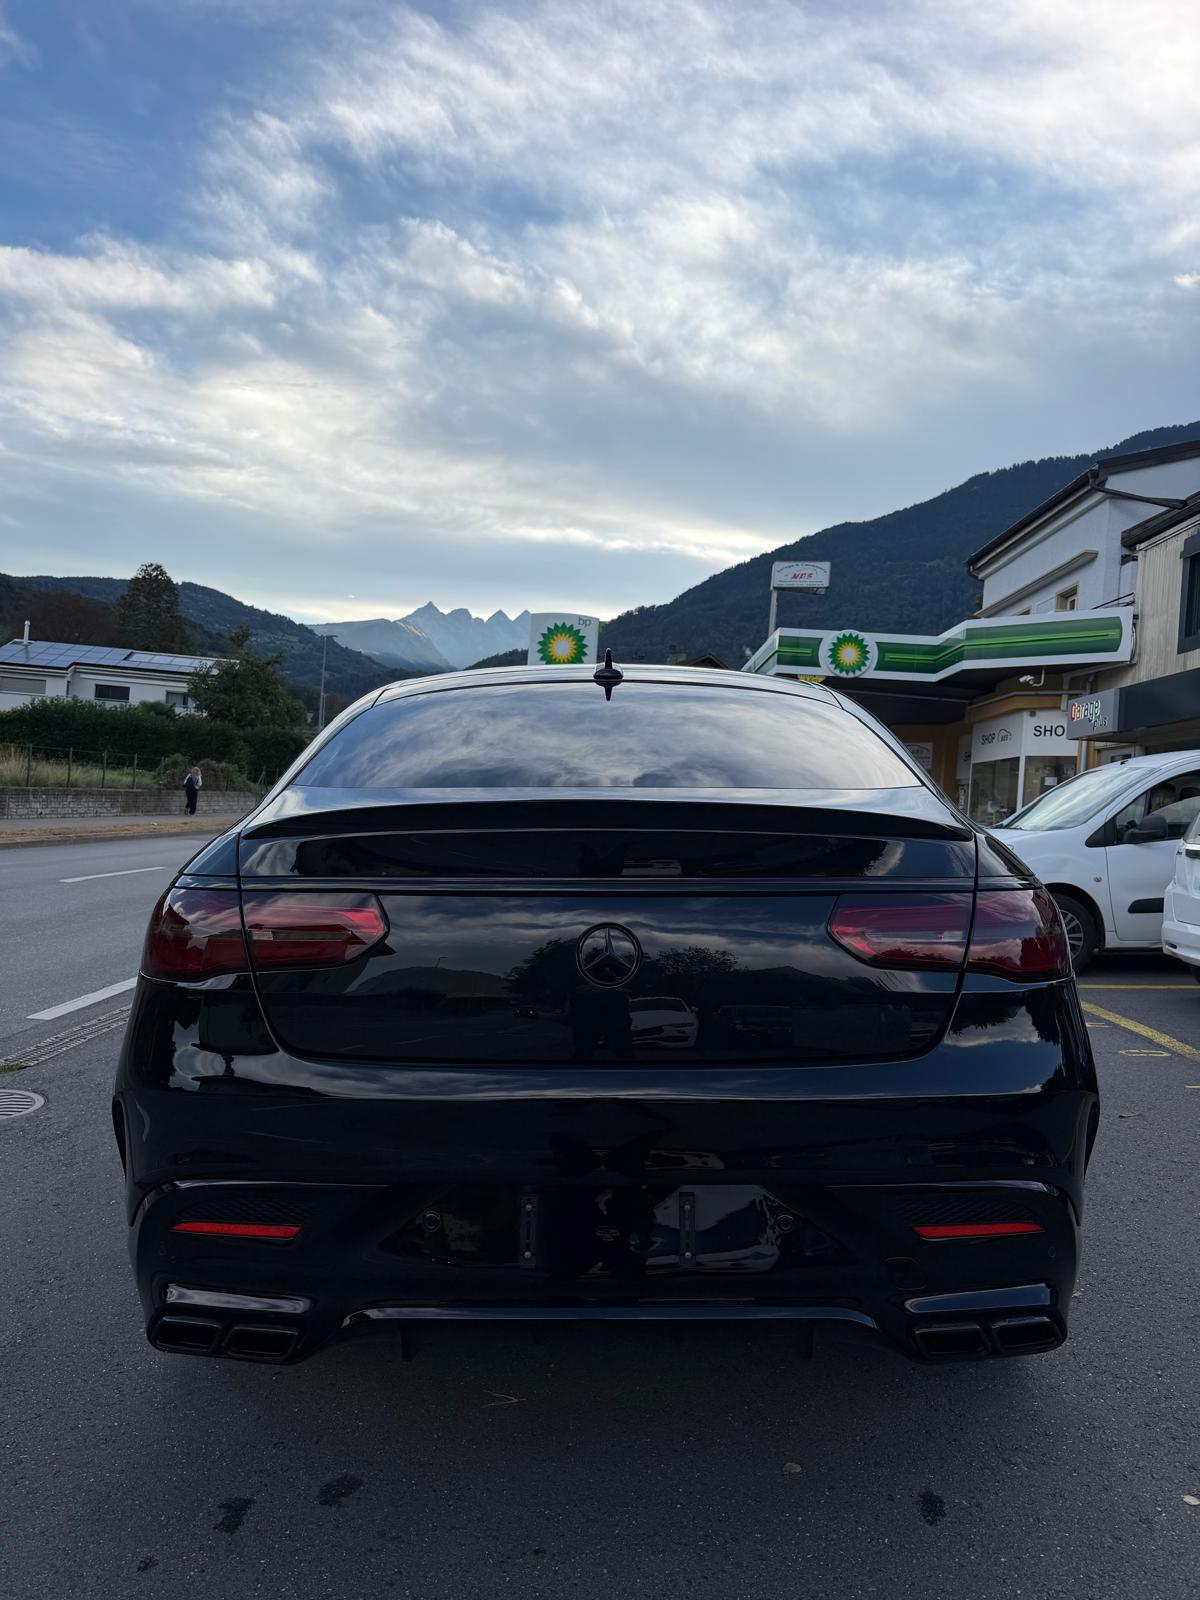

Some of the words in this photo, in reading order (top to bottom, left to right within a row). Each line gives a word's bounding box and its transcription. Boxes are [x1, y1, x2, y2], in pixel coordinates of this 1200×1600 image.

[578, 616, 592, 628] bp
[1093, 716, 1108, 732] plus
[1033, 725, 1066, 737] SHO
[981, 732, 996, 746] SHOP
